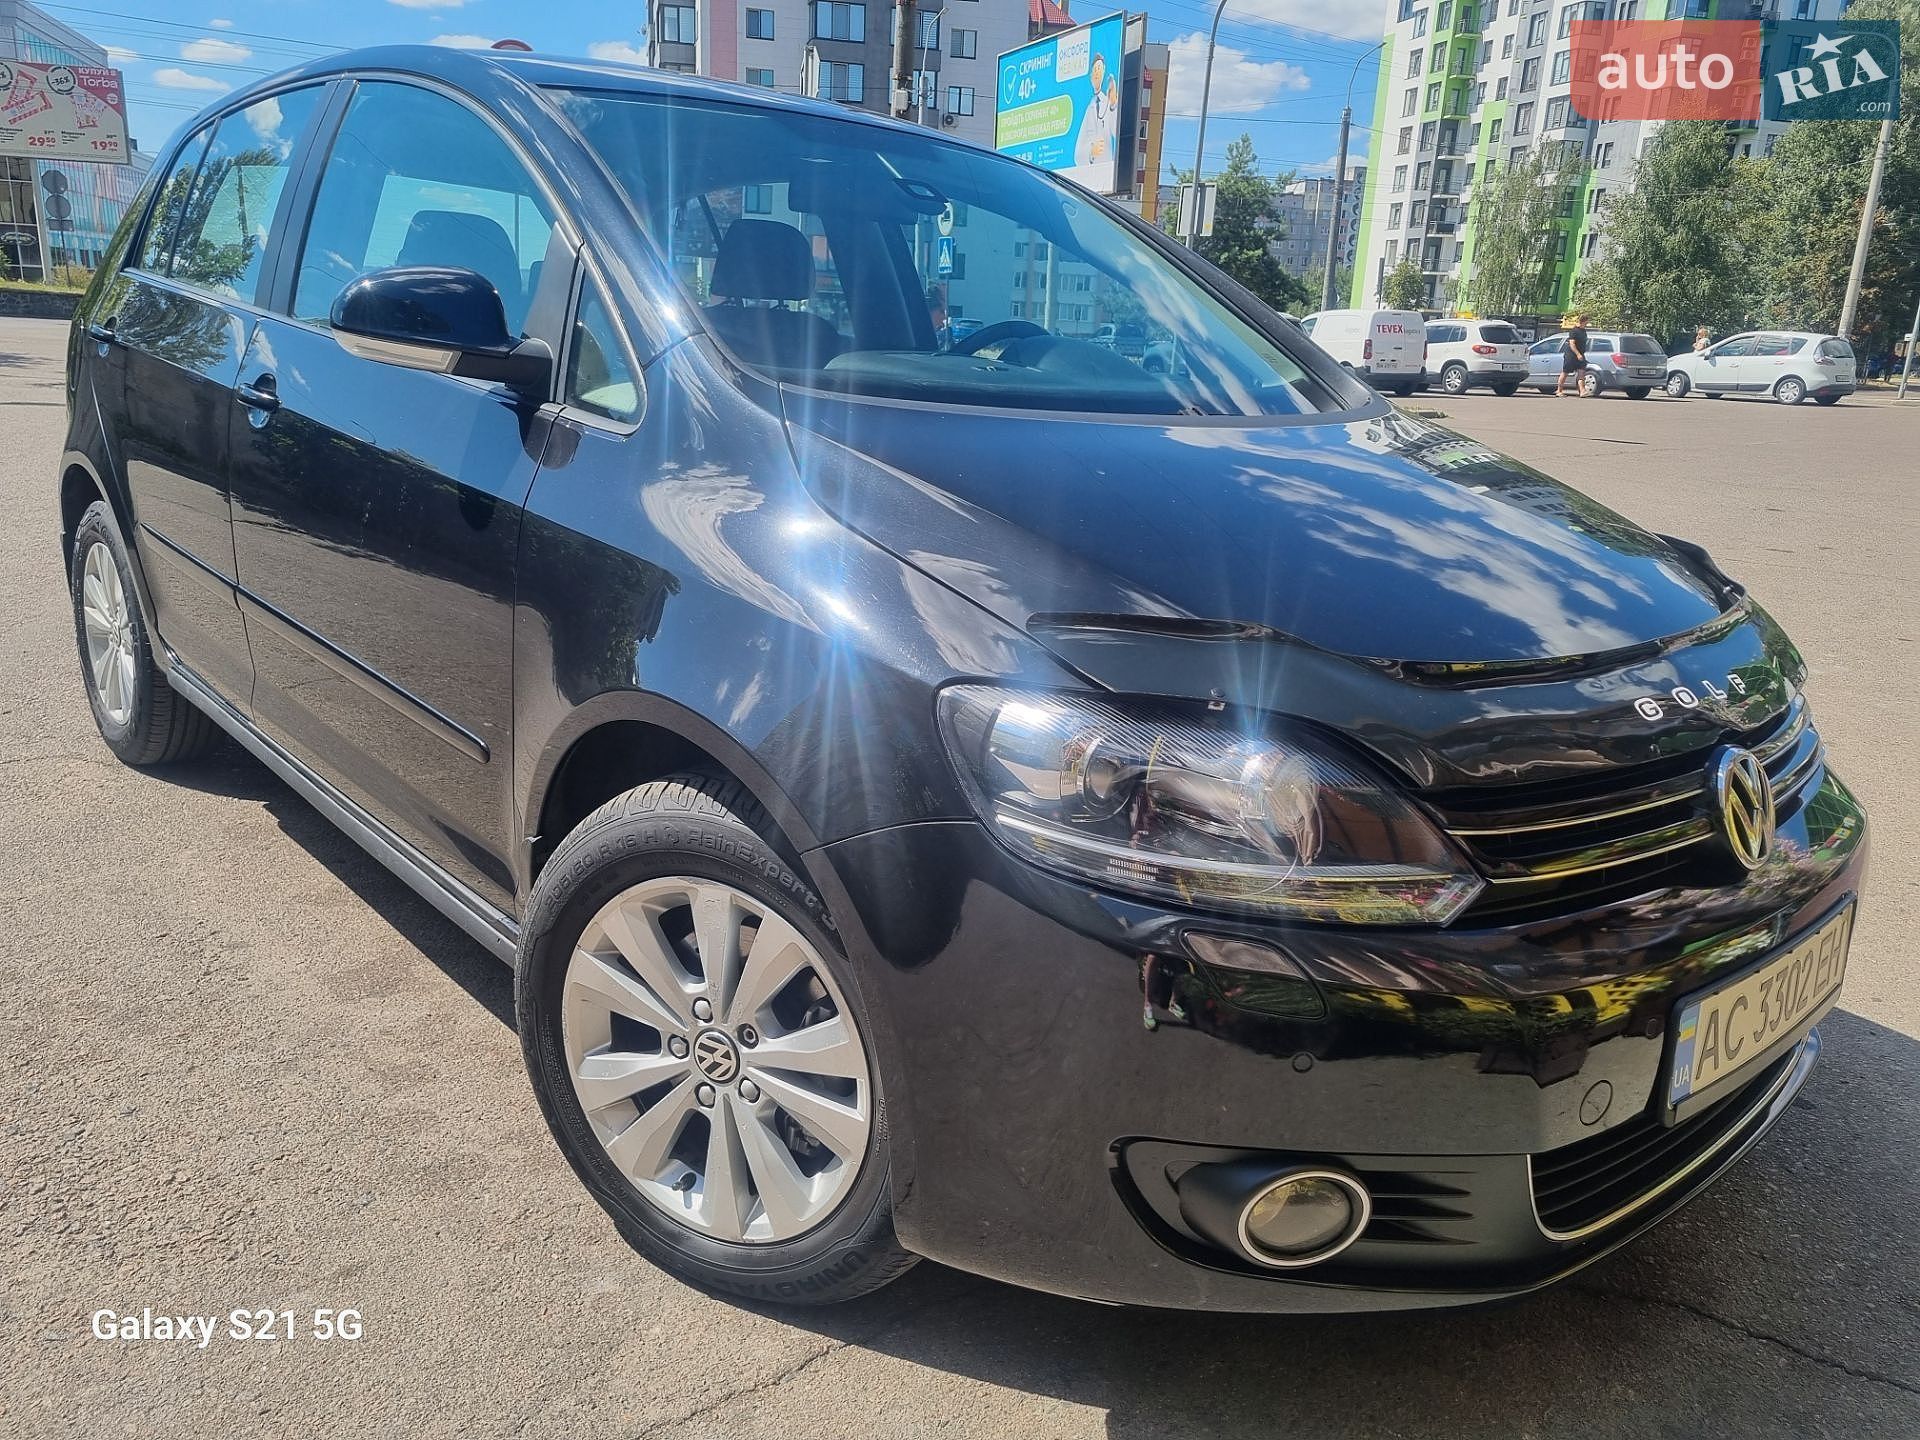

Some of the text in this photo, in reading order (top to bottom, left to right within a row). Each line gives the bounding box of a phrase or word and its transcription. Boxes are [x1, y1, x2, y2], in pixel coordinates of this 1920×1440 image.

[1019, 52, 1053, 76] СКРИНІНГ
[79, 76, 118, 89] Torba
[1018, 78, 1037, 100] 40+
[1376, 324, 1404, 334] TEVEX
[1634, 673, 1746, 720] GOLF
[1695, 994, 1748, 1081] AC
[1753, 950, 1814, 1043] 3302
[1673, 1068, 1690, 1089] UA
